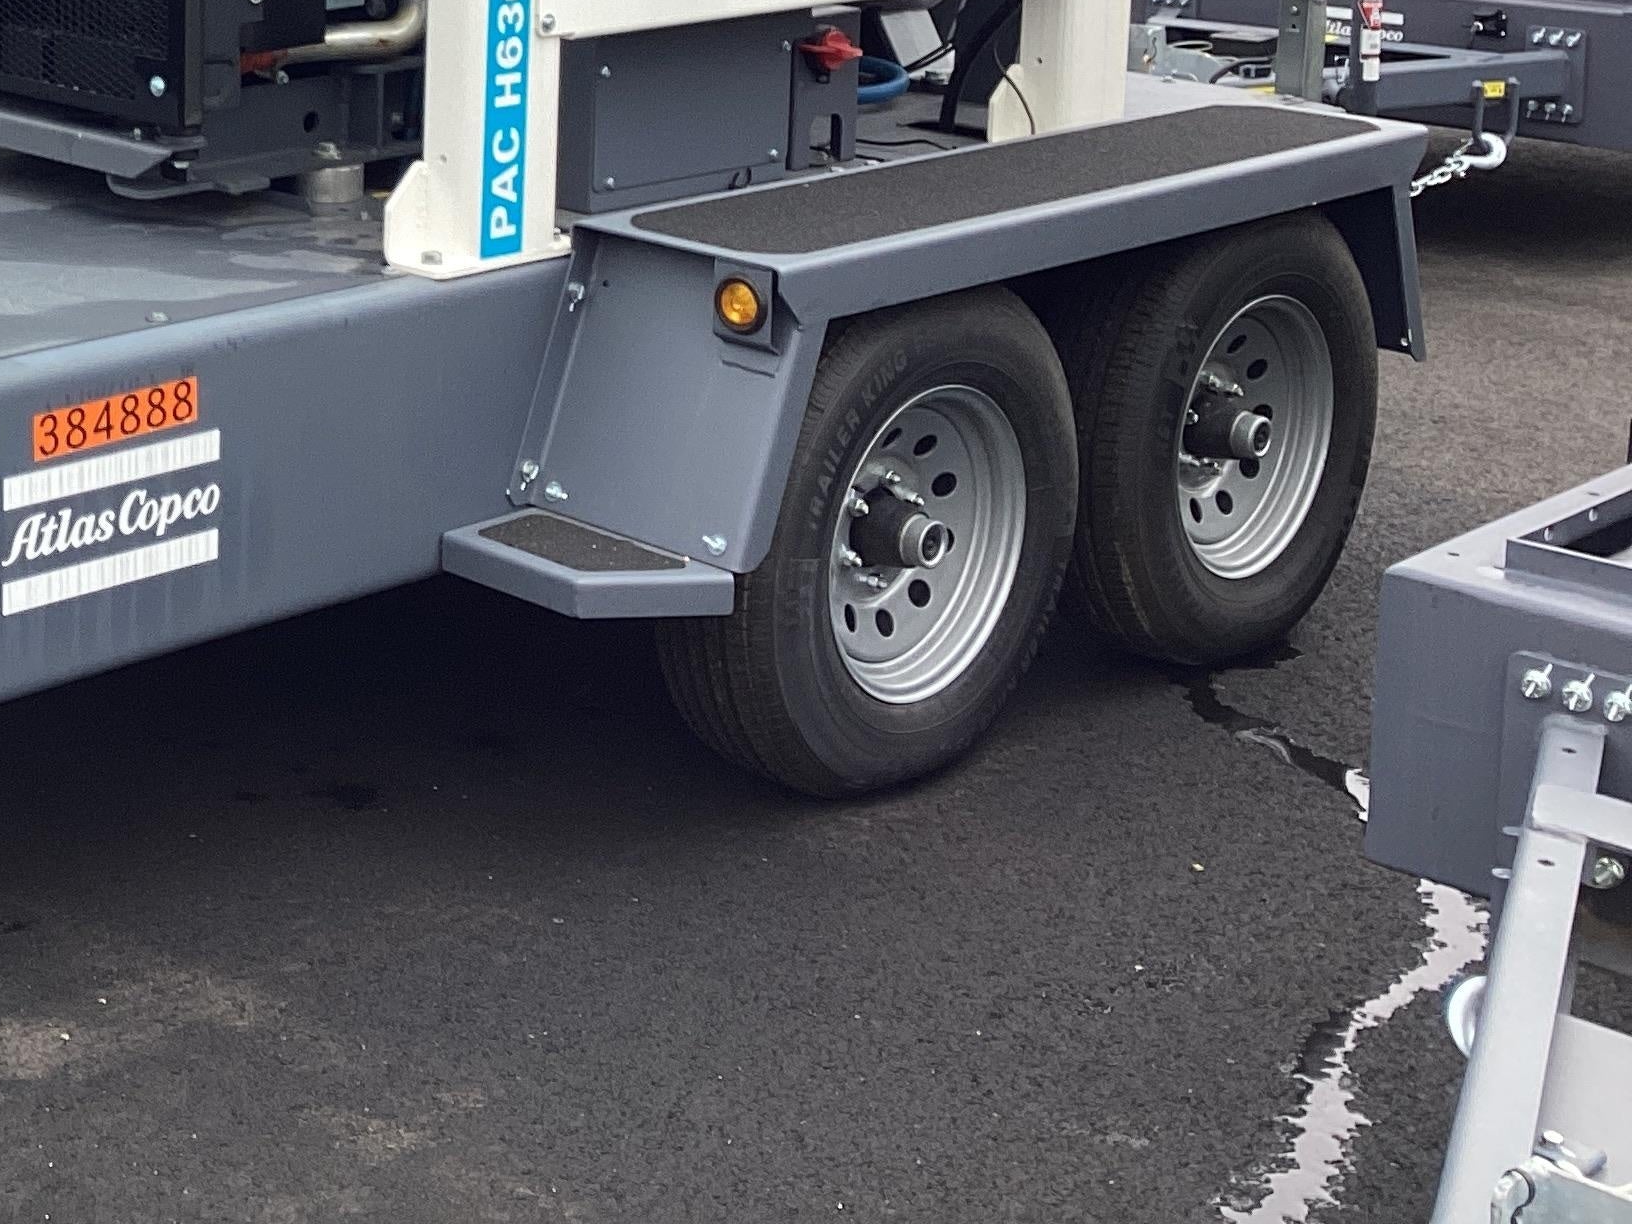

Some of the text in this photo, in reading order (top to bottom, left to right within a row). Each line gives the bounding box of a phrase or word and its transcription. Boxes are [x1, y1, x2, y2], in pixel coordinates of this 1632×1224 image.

[489, 126, 520, 240] PAC
[39, 381, 193, 455] 384888
[1, 483, 221, 567] Atlas Copco
